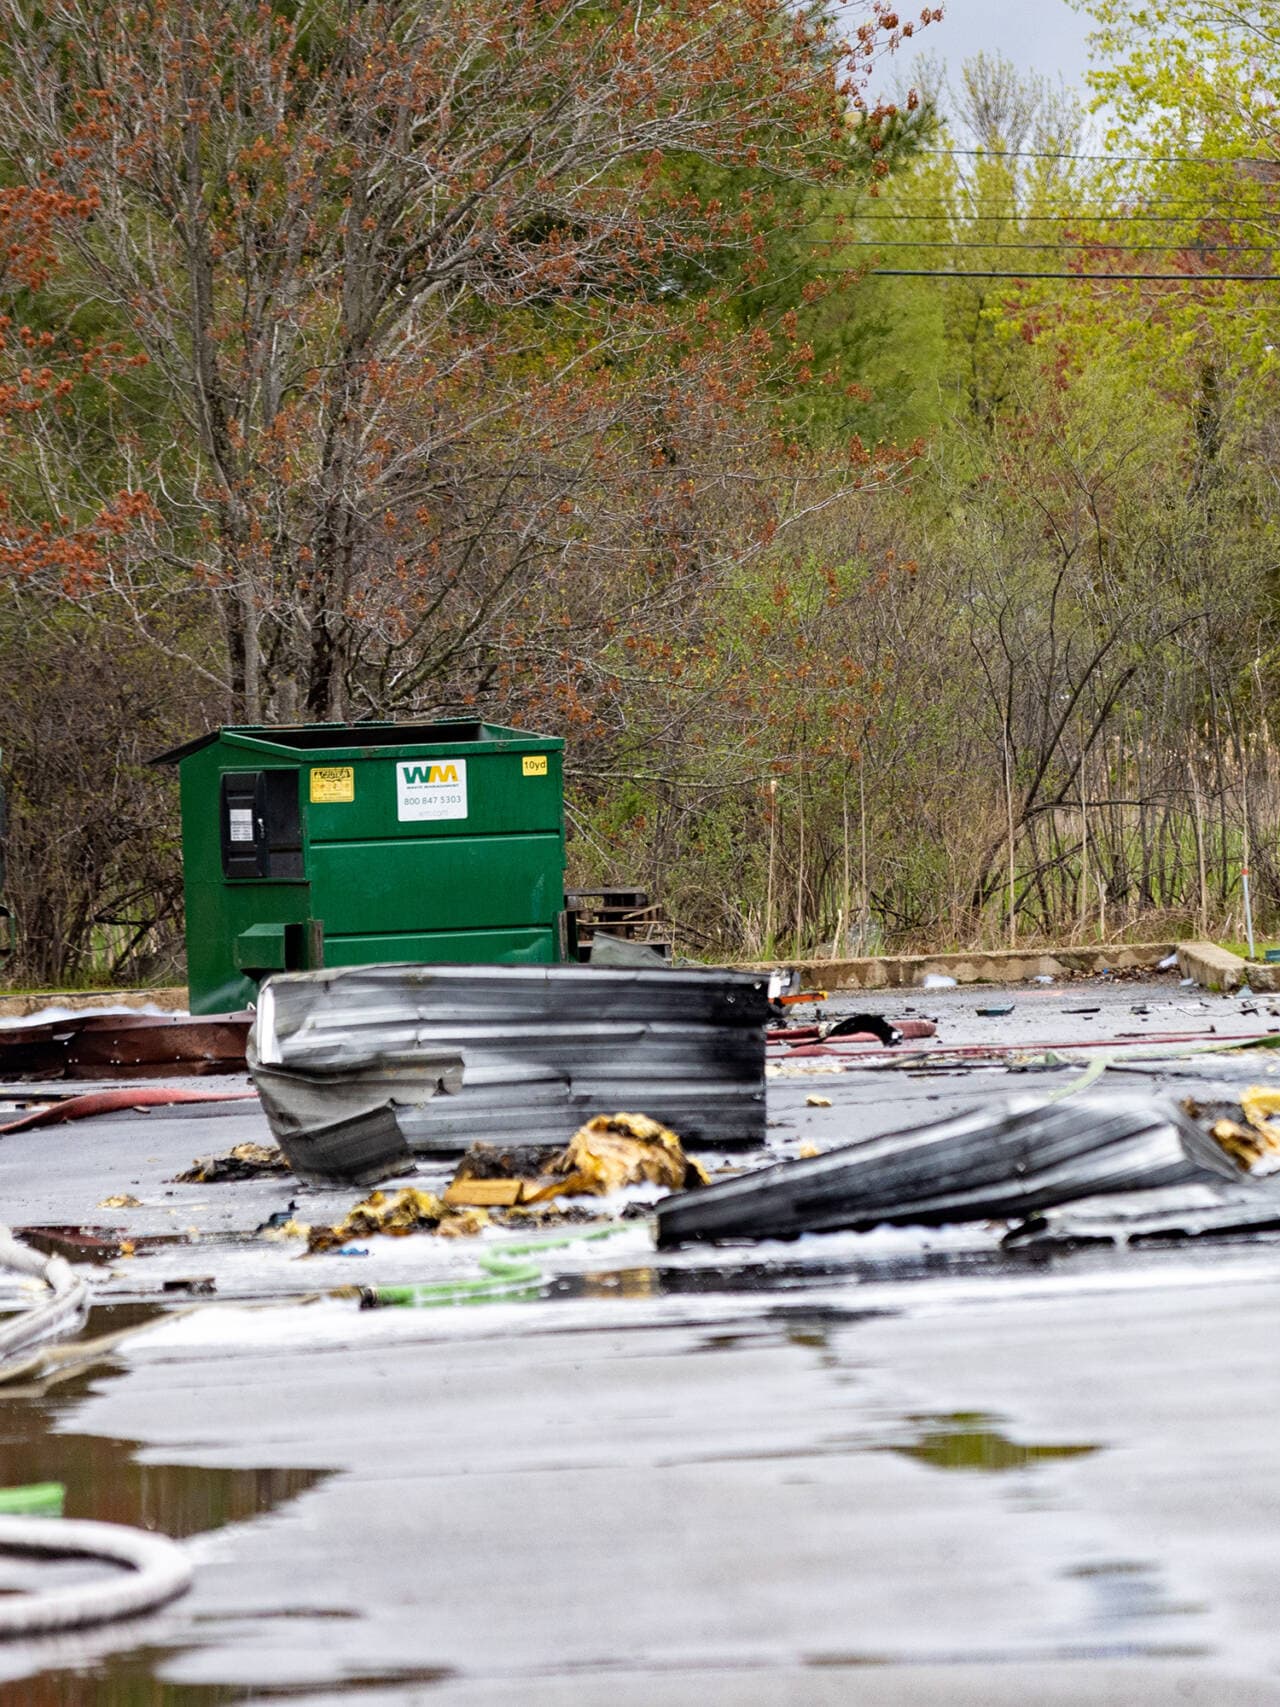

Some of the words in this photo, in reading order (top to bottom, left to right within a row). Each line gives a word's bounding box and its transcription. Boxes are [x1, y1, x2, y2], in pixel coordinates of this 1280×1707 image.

[525, 760, 546, 771] 10yd
[403, 765, 458, 784] WM
[404, 797, 420, 806] 800
[440, 795, 462, 804] 5303
